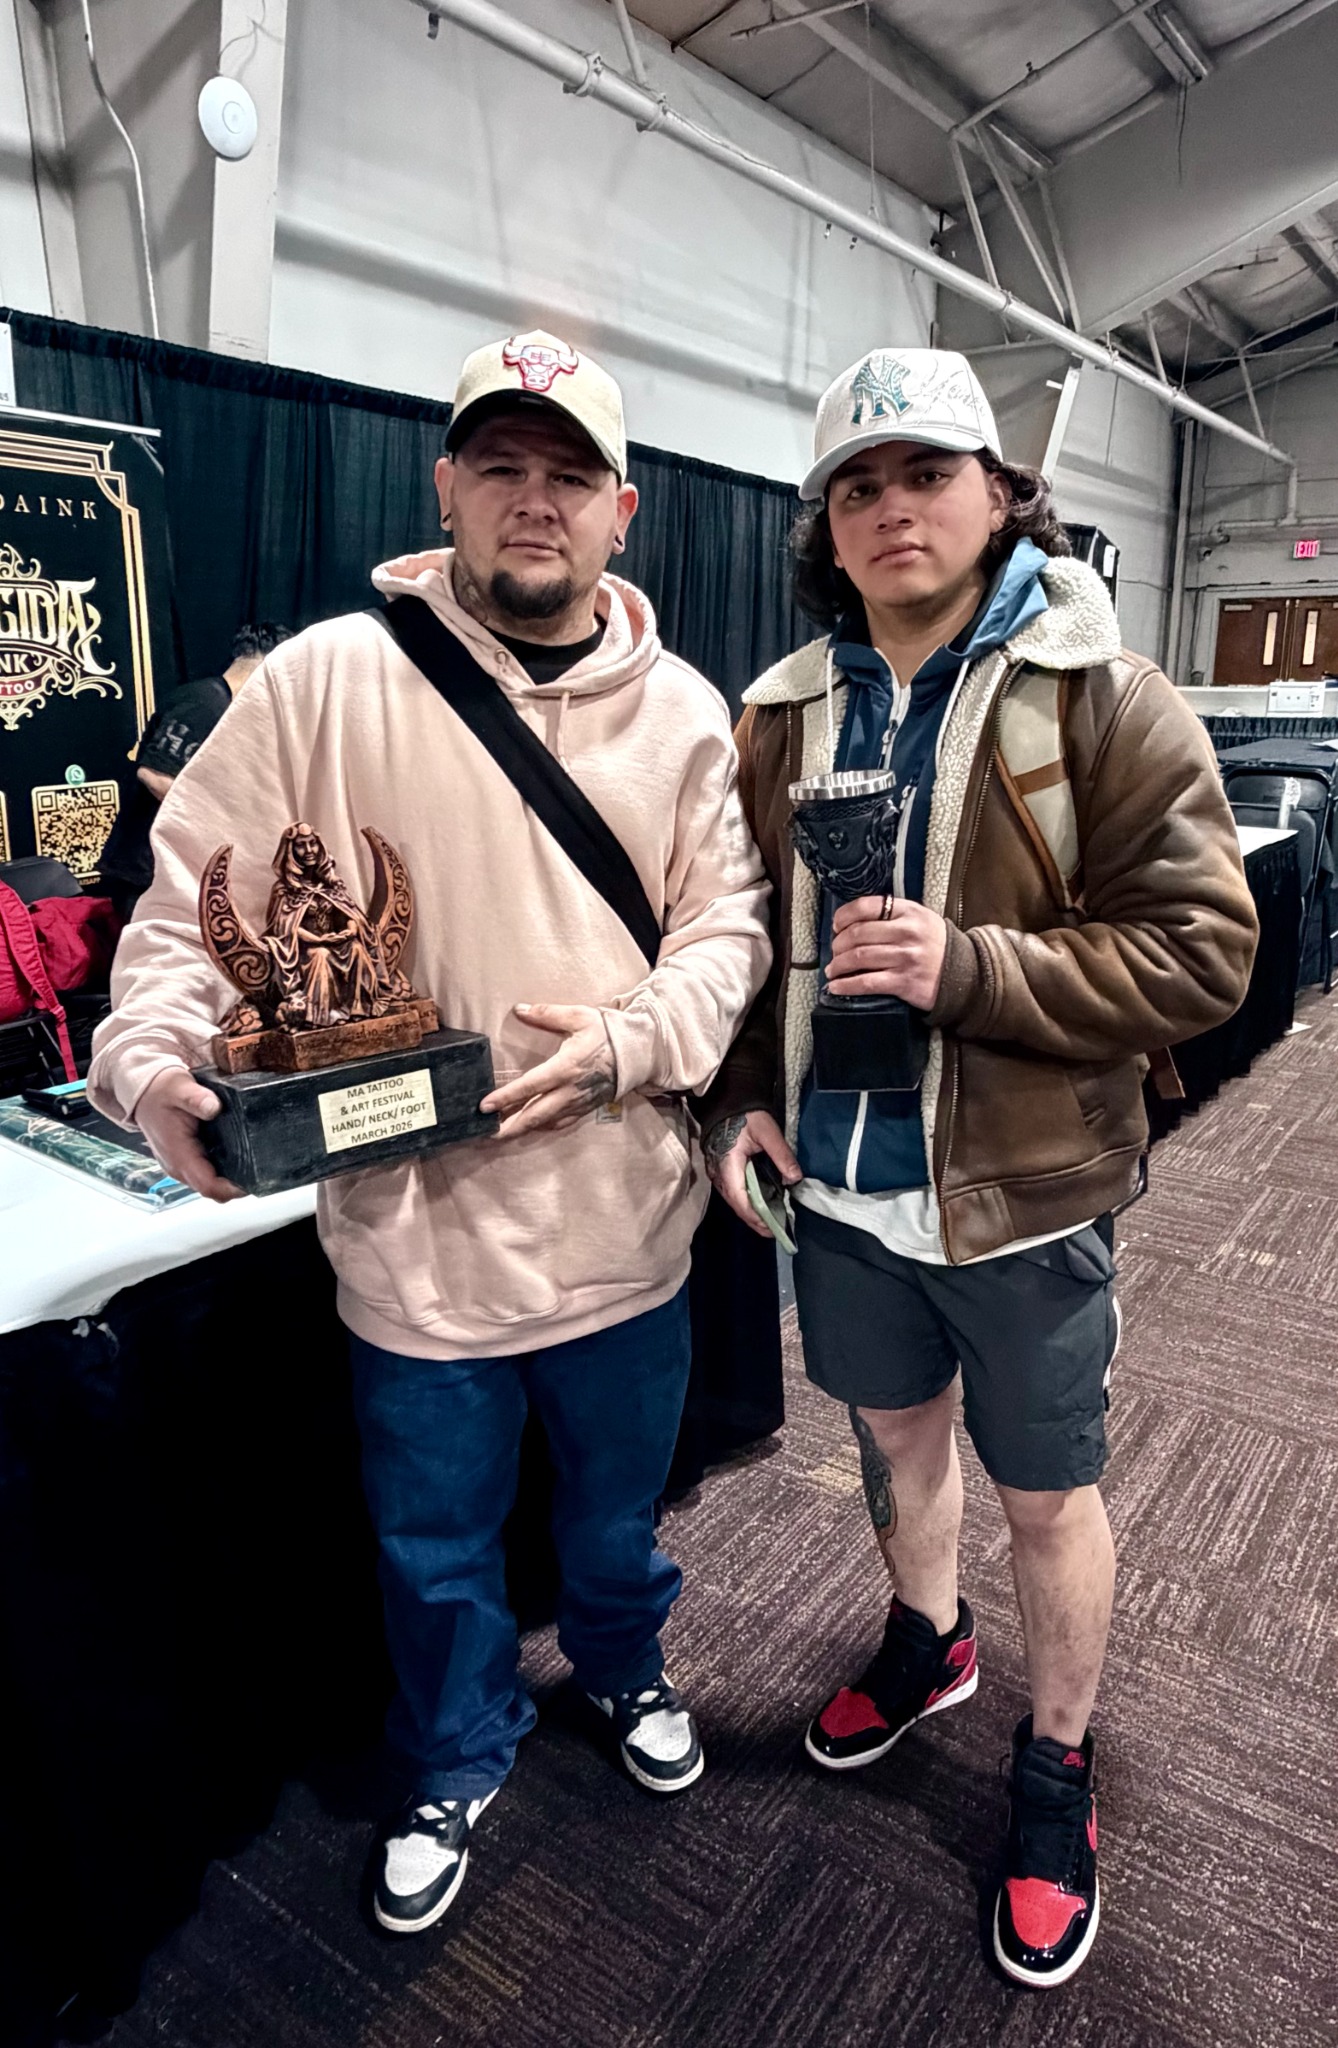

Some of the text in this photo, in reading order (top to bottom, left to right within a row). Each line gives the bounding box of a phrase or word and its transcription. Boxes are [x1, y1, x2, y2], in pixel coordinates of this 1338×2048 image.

[1296, 541, 1319, 558] EXIT
[347, 1077, 404, 1099] MA TATTOO
[340, 1090, 415, 1116] & ART FESTIVAL
[331, 1101, 427, 1134] HAND/ NECK/ FOOT
[350, 1120, 413, 1144] MARCH 2026
